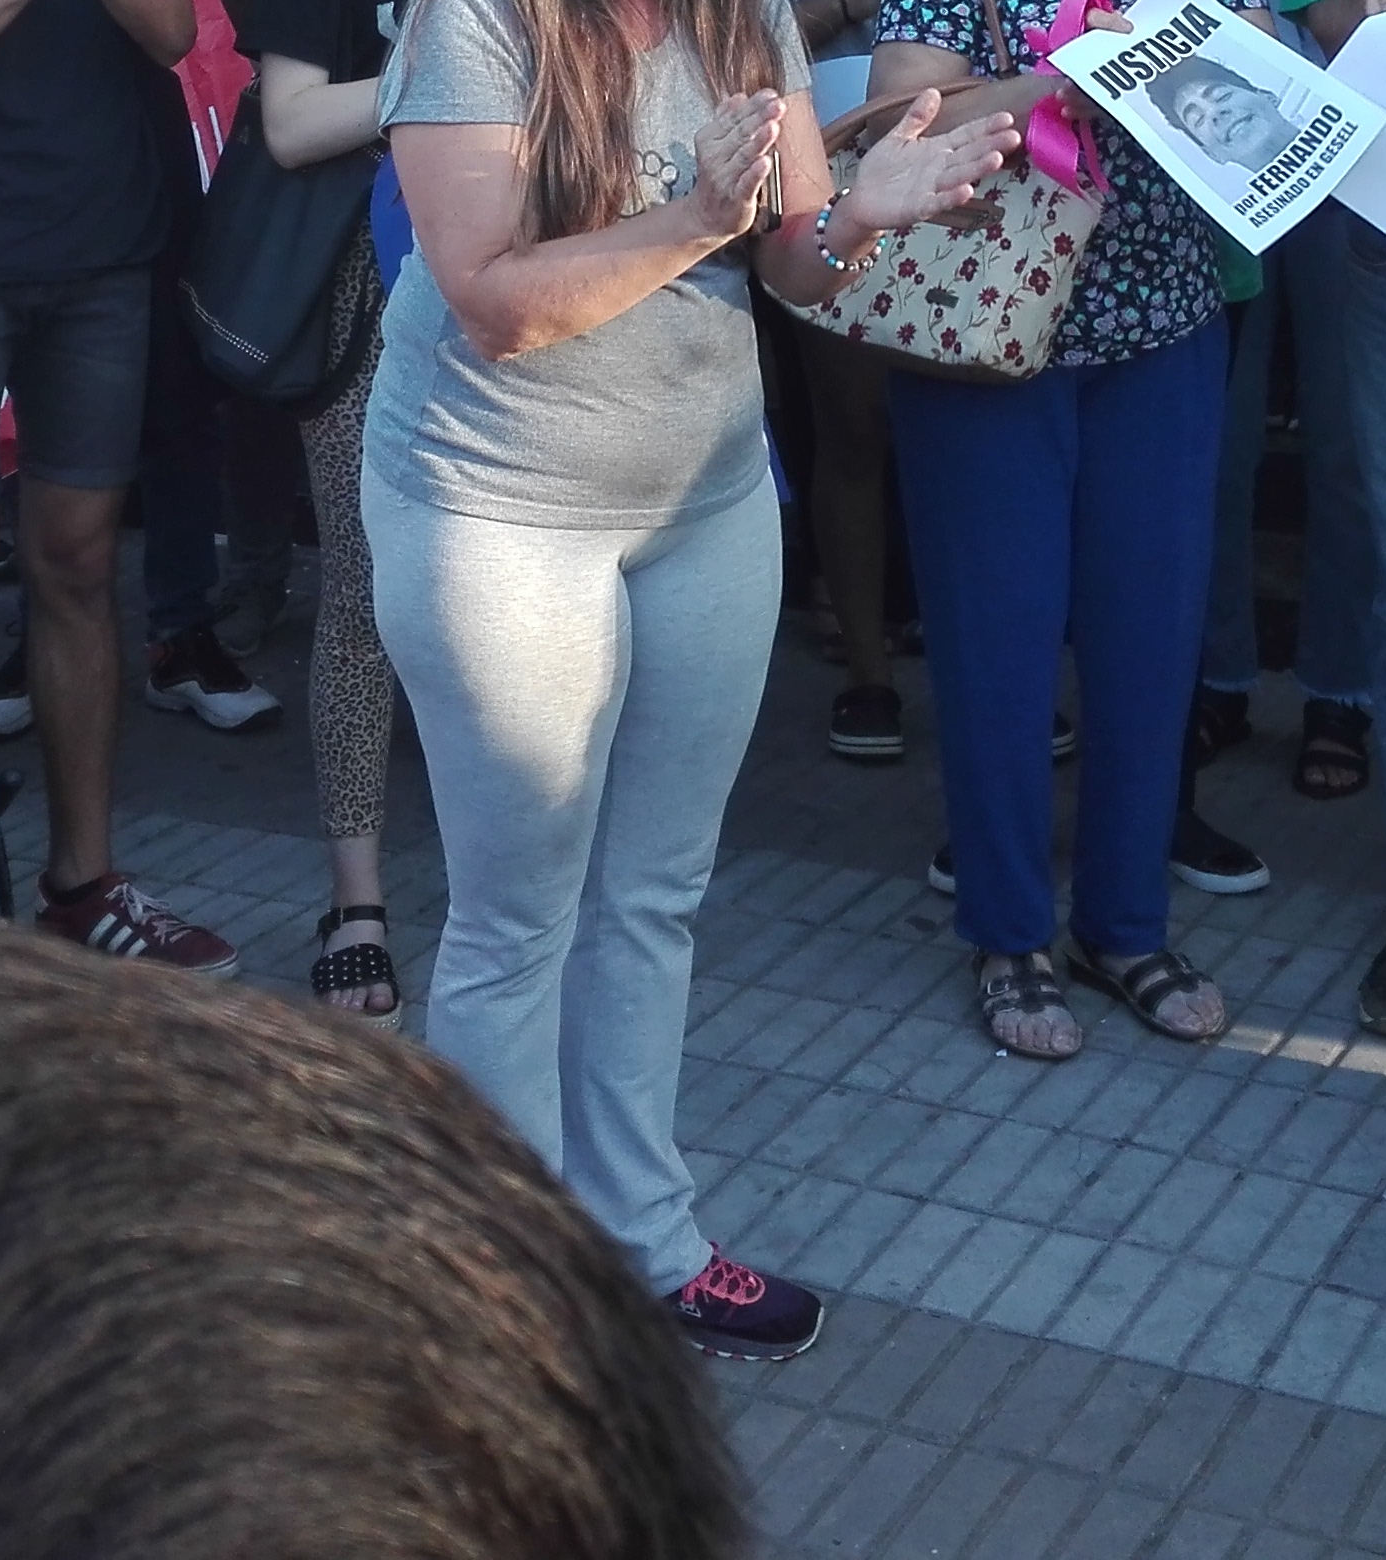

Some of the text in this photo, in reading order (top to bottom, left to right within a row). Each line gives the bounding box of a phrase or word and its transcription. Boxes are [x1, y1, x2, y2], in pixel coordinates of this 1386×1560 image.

[1090, 2, 1223, 100] JUSTICIA
[1233, 103, 1344, 217] por FERNANDO
[1248, 122, 1359, 229] ASESINADO EN GESELL
